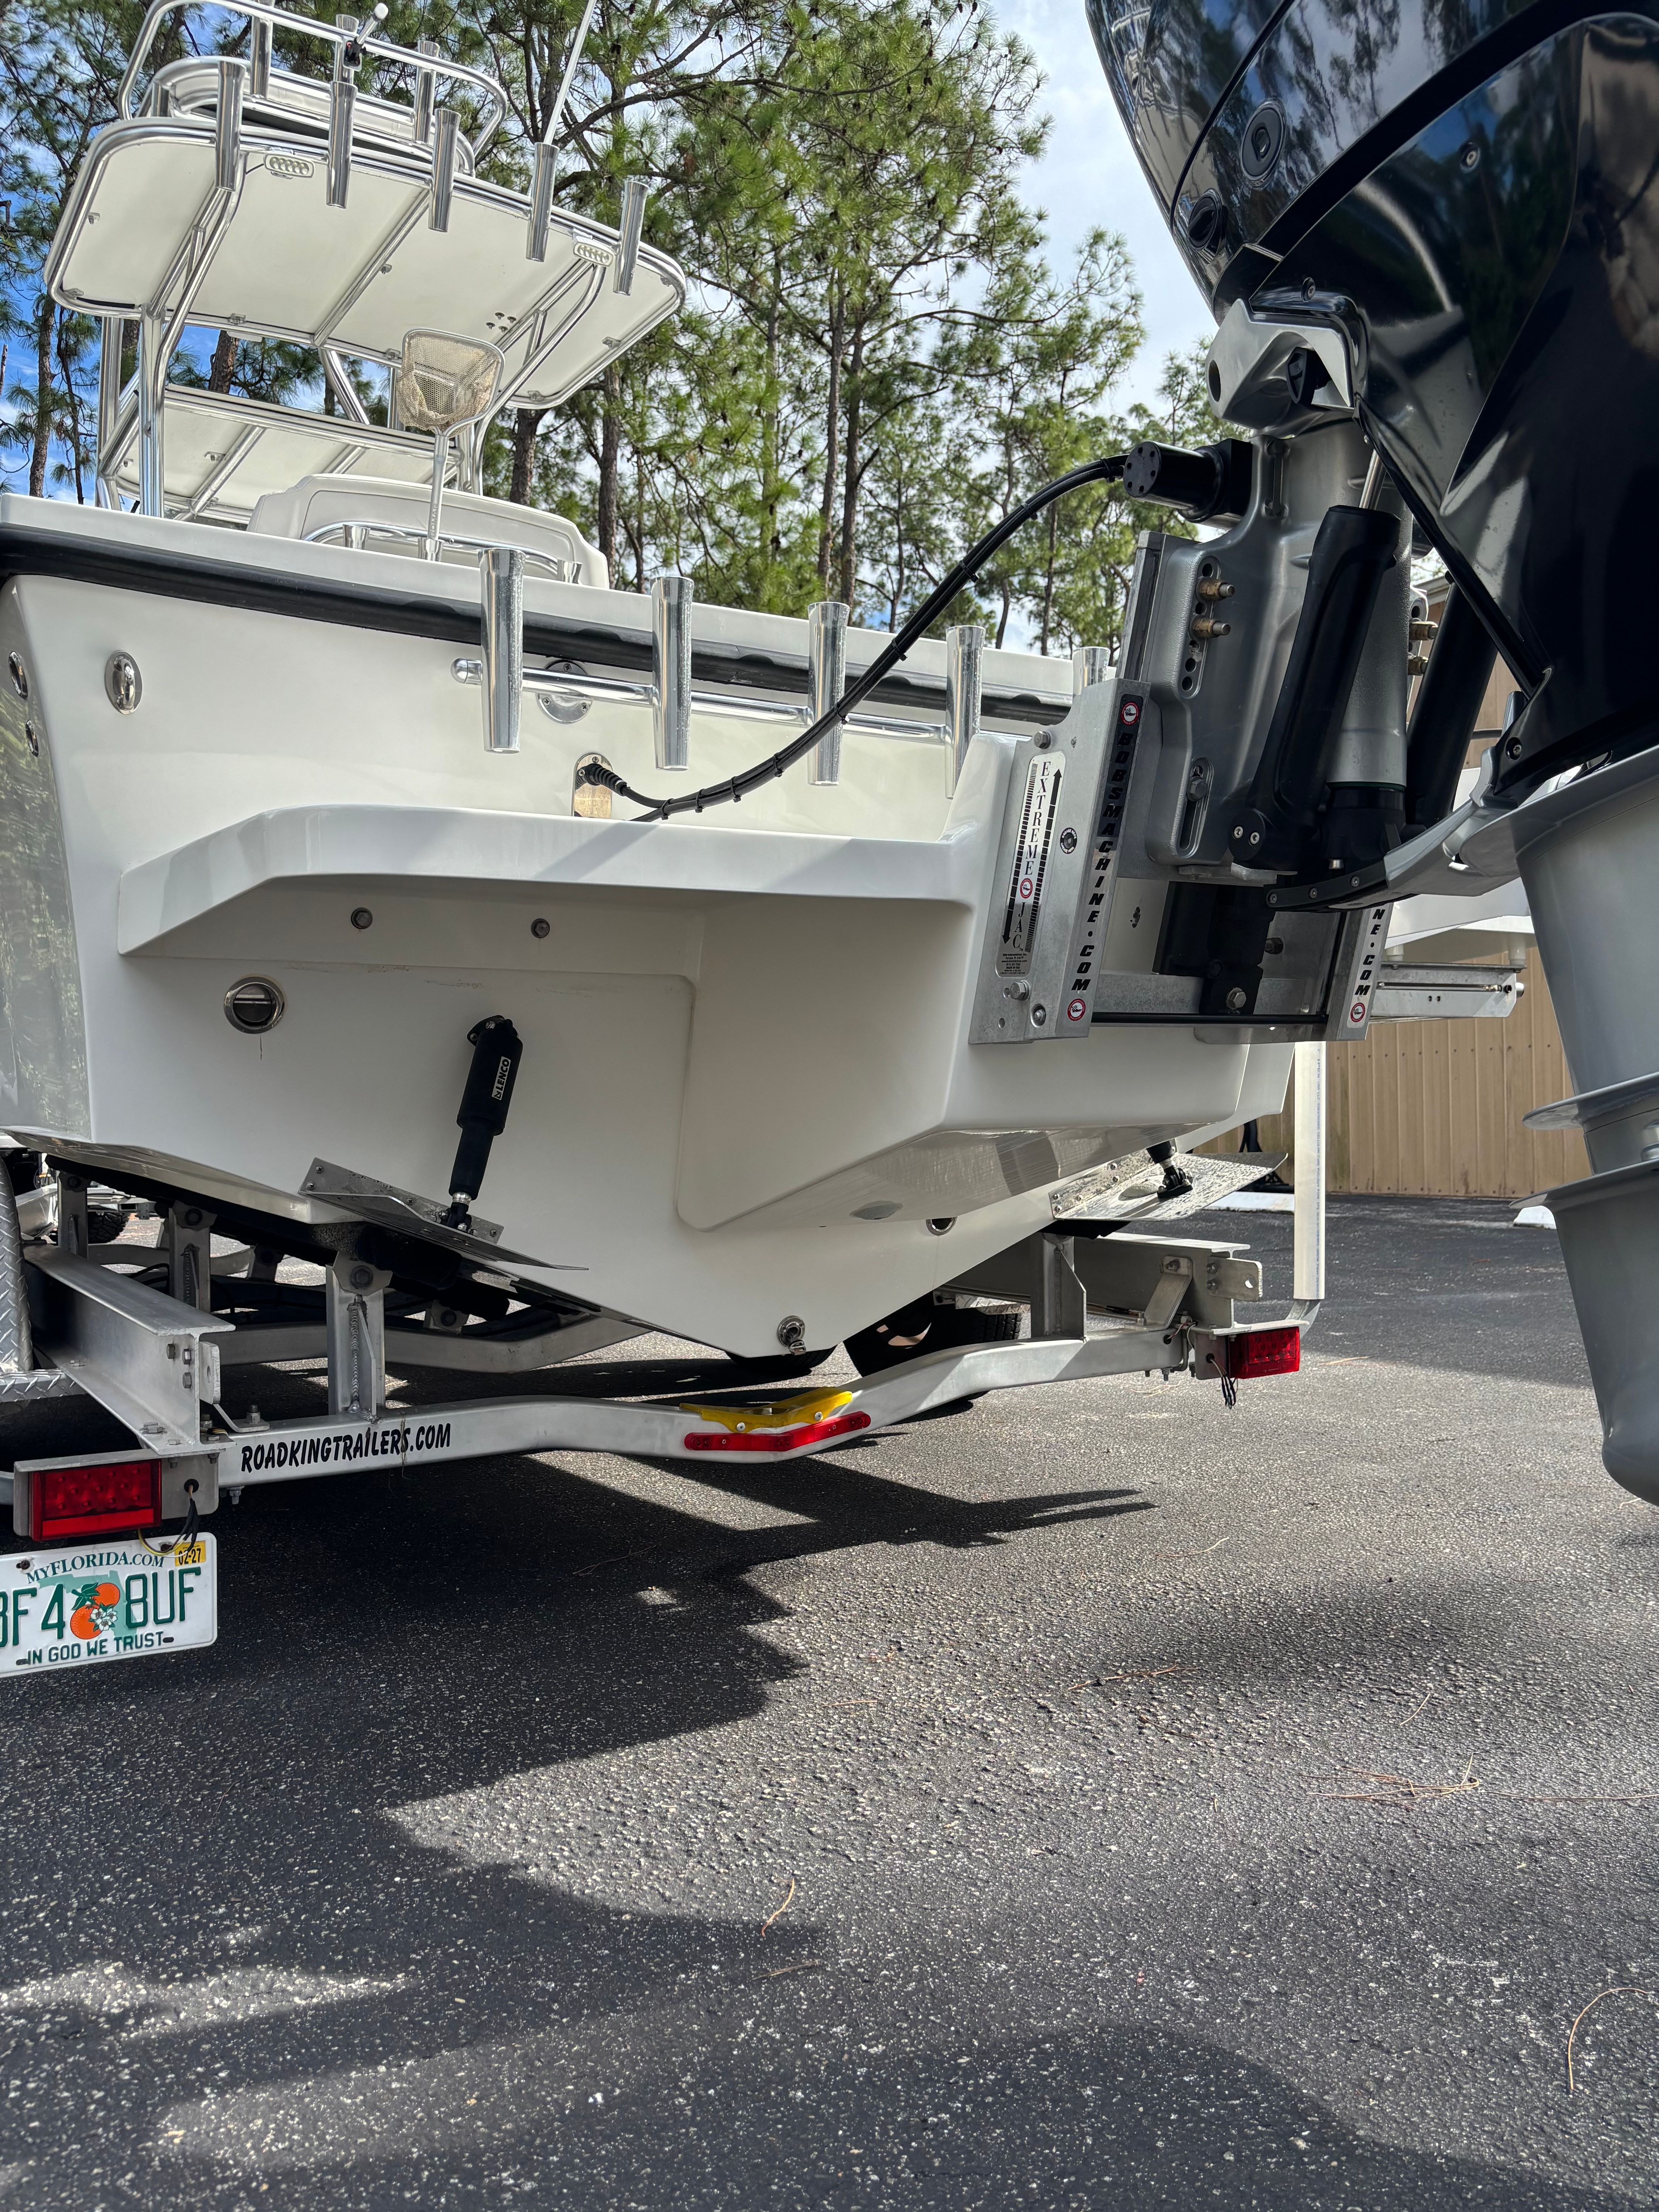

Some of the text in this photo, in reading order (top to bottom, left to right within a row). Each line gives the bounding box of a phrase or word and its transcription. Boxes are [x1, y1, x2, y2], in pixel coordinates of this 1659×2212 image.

[1024, 761, 1051, 875] EXTREME
[1072, 732, 1133, 990] BOBSMACHINE.COM
[1013, 902, 1026, 948] JAC
[496, 1059, 510, 1091] LENCO
[241, 1423, 451, 1473] ROADKINGTRAILERS.COM
[27, 1551, 165, 1584] MYFLORIDA.COM
[178, 1548, 201, 1565] 02-27
[125, 1567, 201, 1628] 8UF
[28, 1631, 164, 1665] IN GOD WE TRUST
